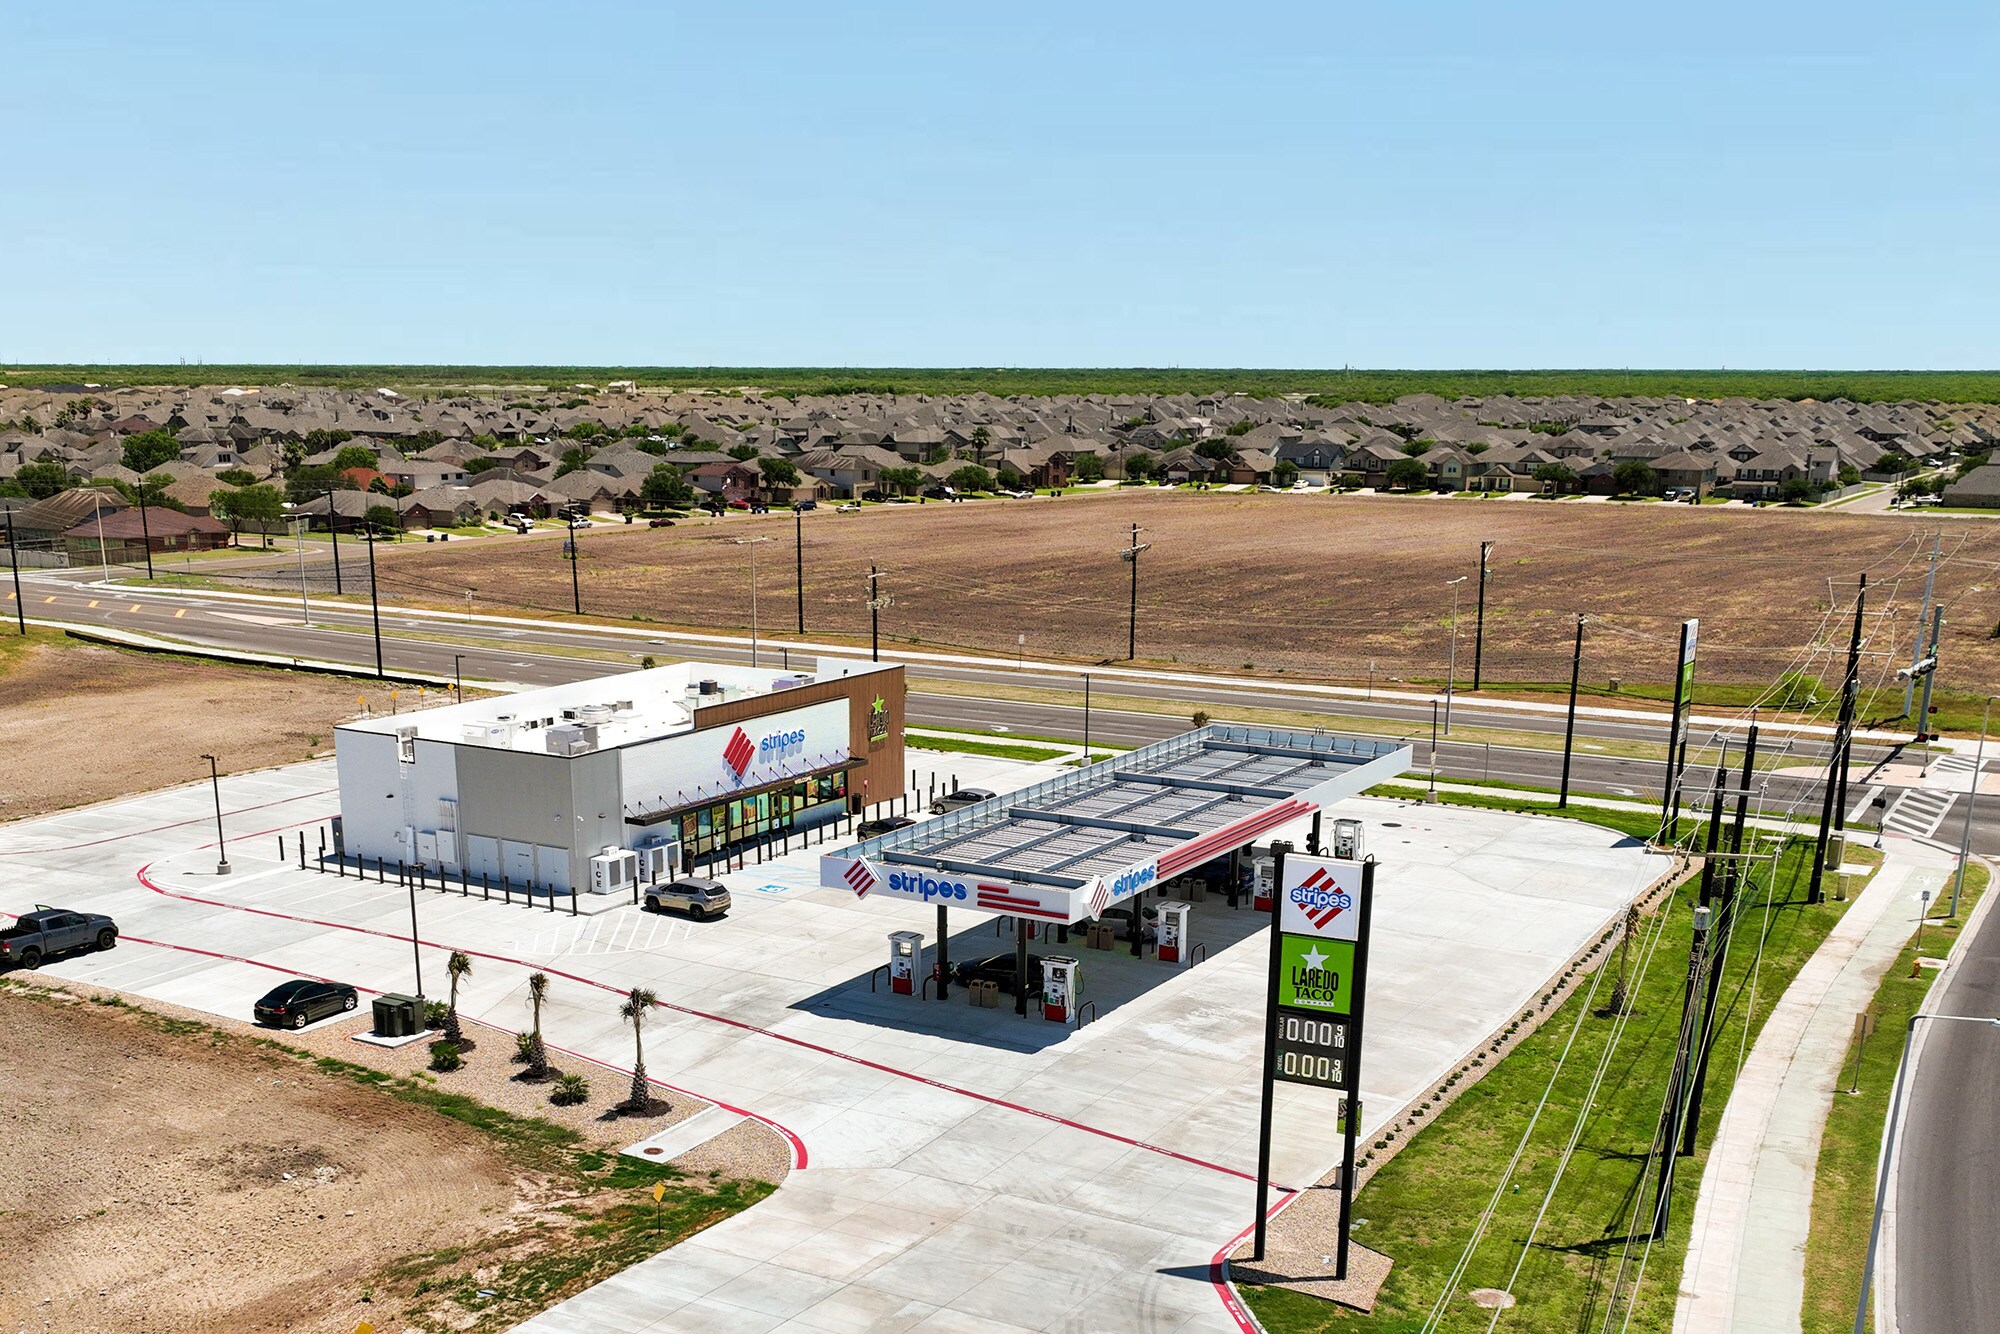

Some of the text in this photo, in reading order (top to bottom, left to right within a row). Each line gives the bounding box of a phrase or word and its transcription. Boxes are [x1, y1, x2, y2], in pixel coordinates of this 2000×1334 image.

[761, 729, 806, 753] stripes
[889, 871, 967, 902] stripes
[1113, 864, 1155, 896] stripes
[1291, 887, 1351, 909] stripes
[1292, 965, 1339, 992] LAREDO
[1293, 985, 1334, 1002] TACO
[1286, 1017, 1332, 1047] 0.00
[1284, 1051, 1330, 1081] 0.00
